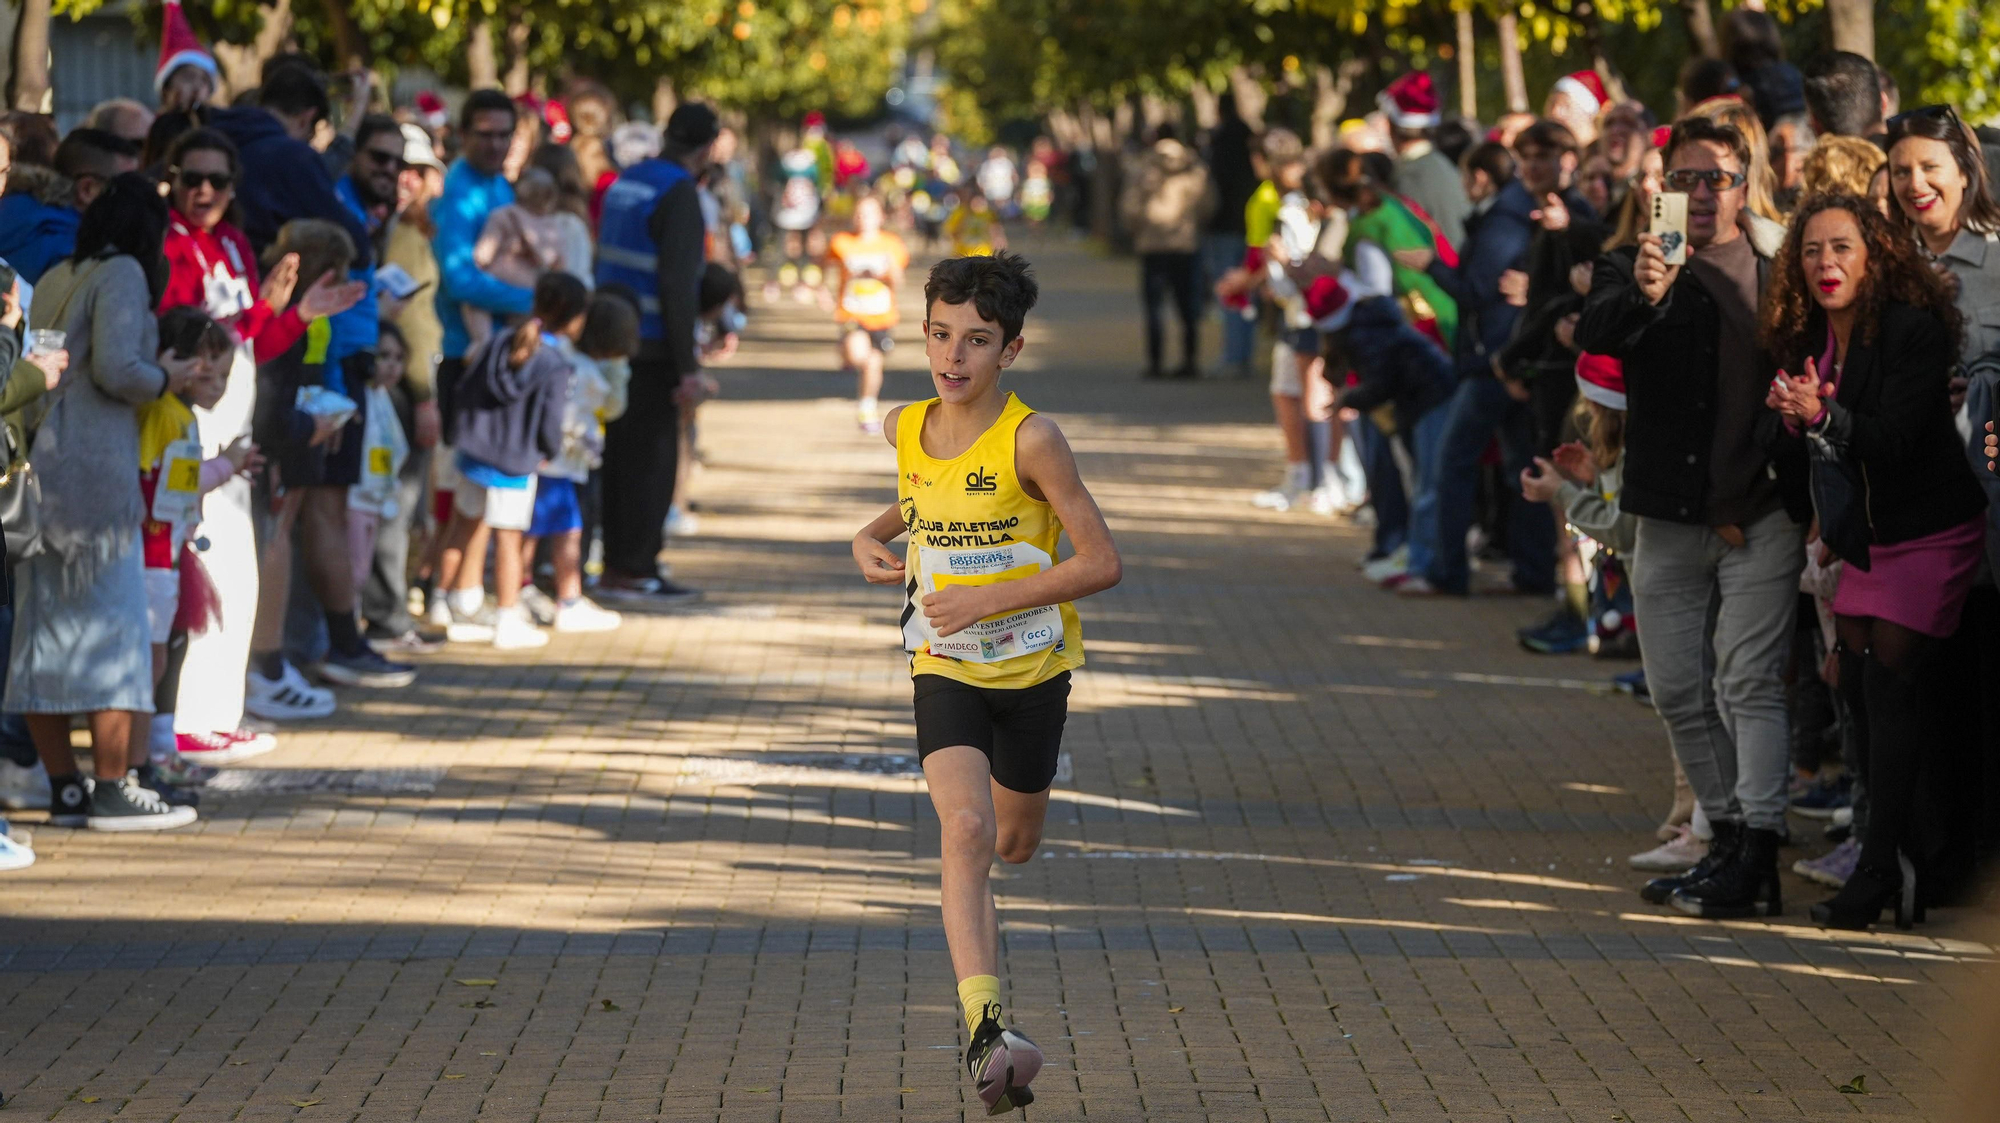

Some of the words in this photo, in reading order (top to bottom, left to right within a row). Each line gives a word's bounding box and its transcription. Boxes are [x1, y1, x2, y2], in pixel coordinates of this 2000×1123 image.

[965, 466, 998, 491] als
[919, 519, 944, 532] CLUB
[948, 517, 1019, 532] ATLETISMO
[926, 533, 1014, 547] MONTILLA
[949, 554, 1014, 566] populares
[968, 619, 1005, 629] LVESTRE
[1006, 606, 1054, 623] CORDOBESA
[1027, 629, 1047, 640] GCC
[944, 642, 979, 651] IMDECO
